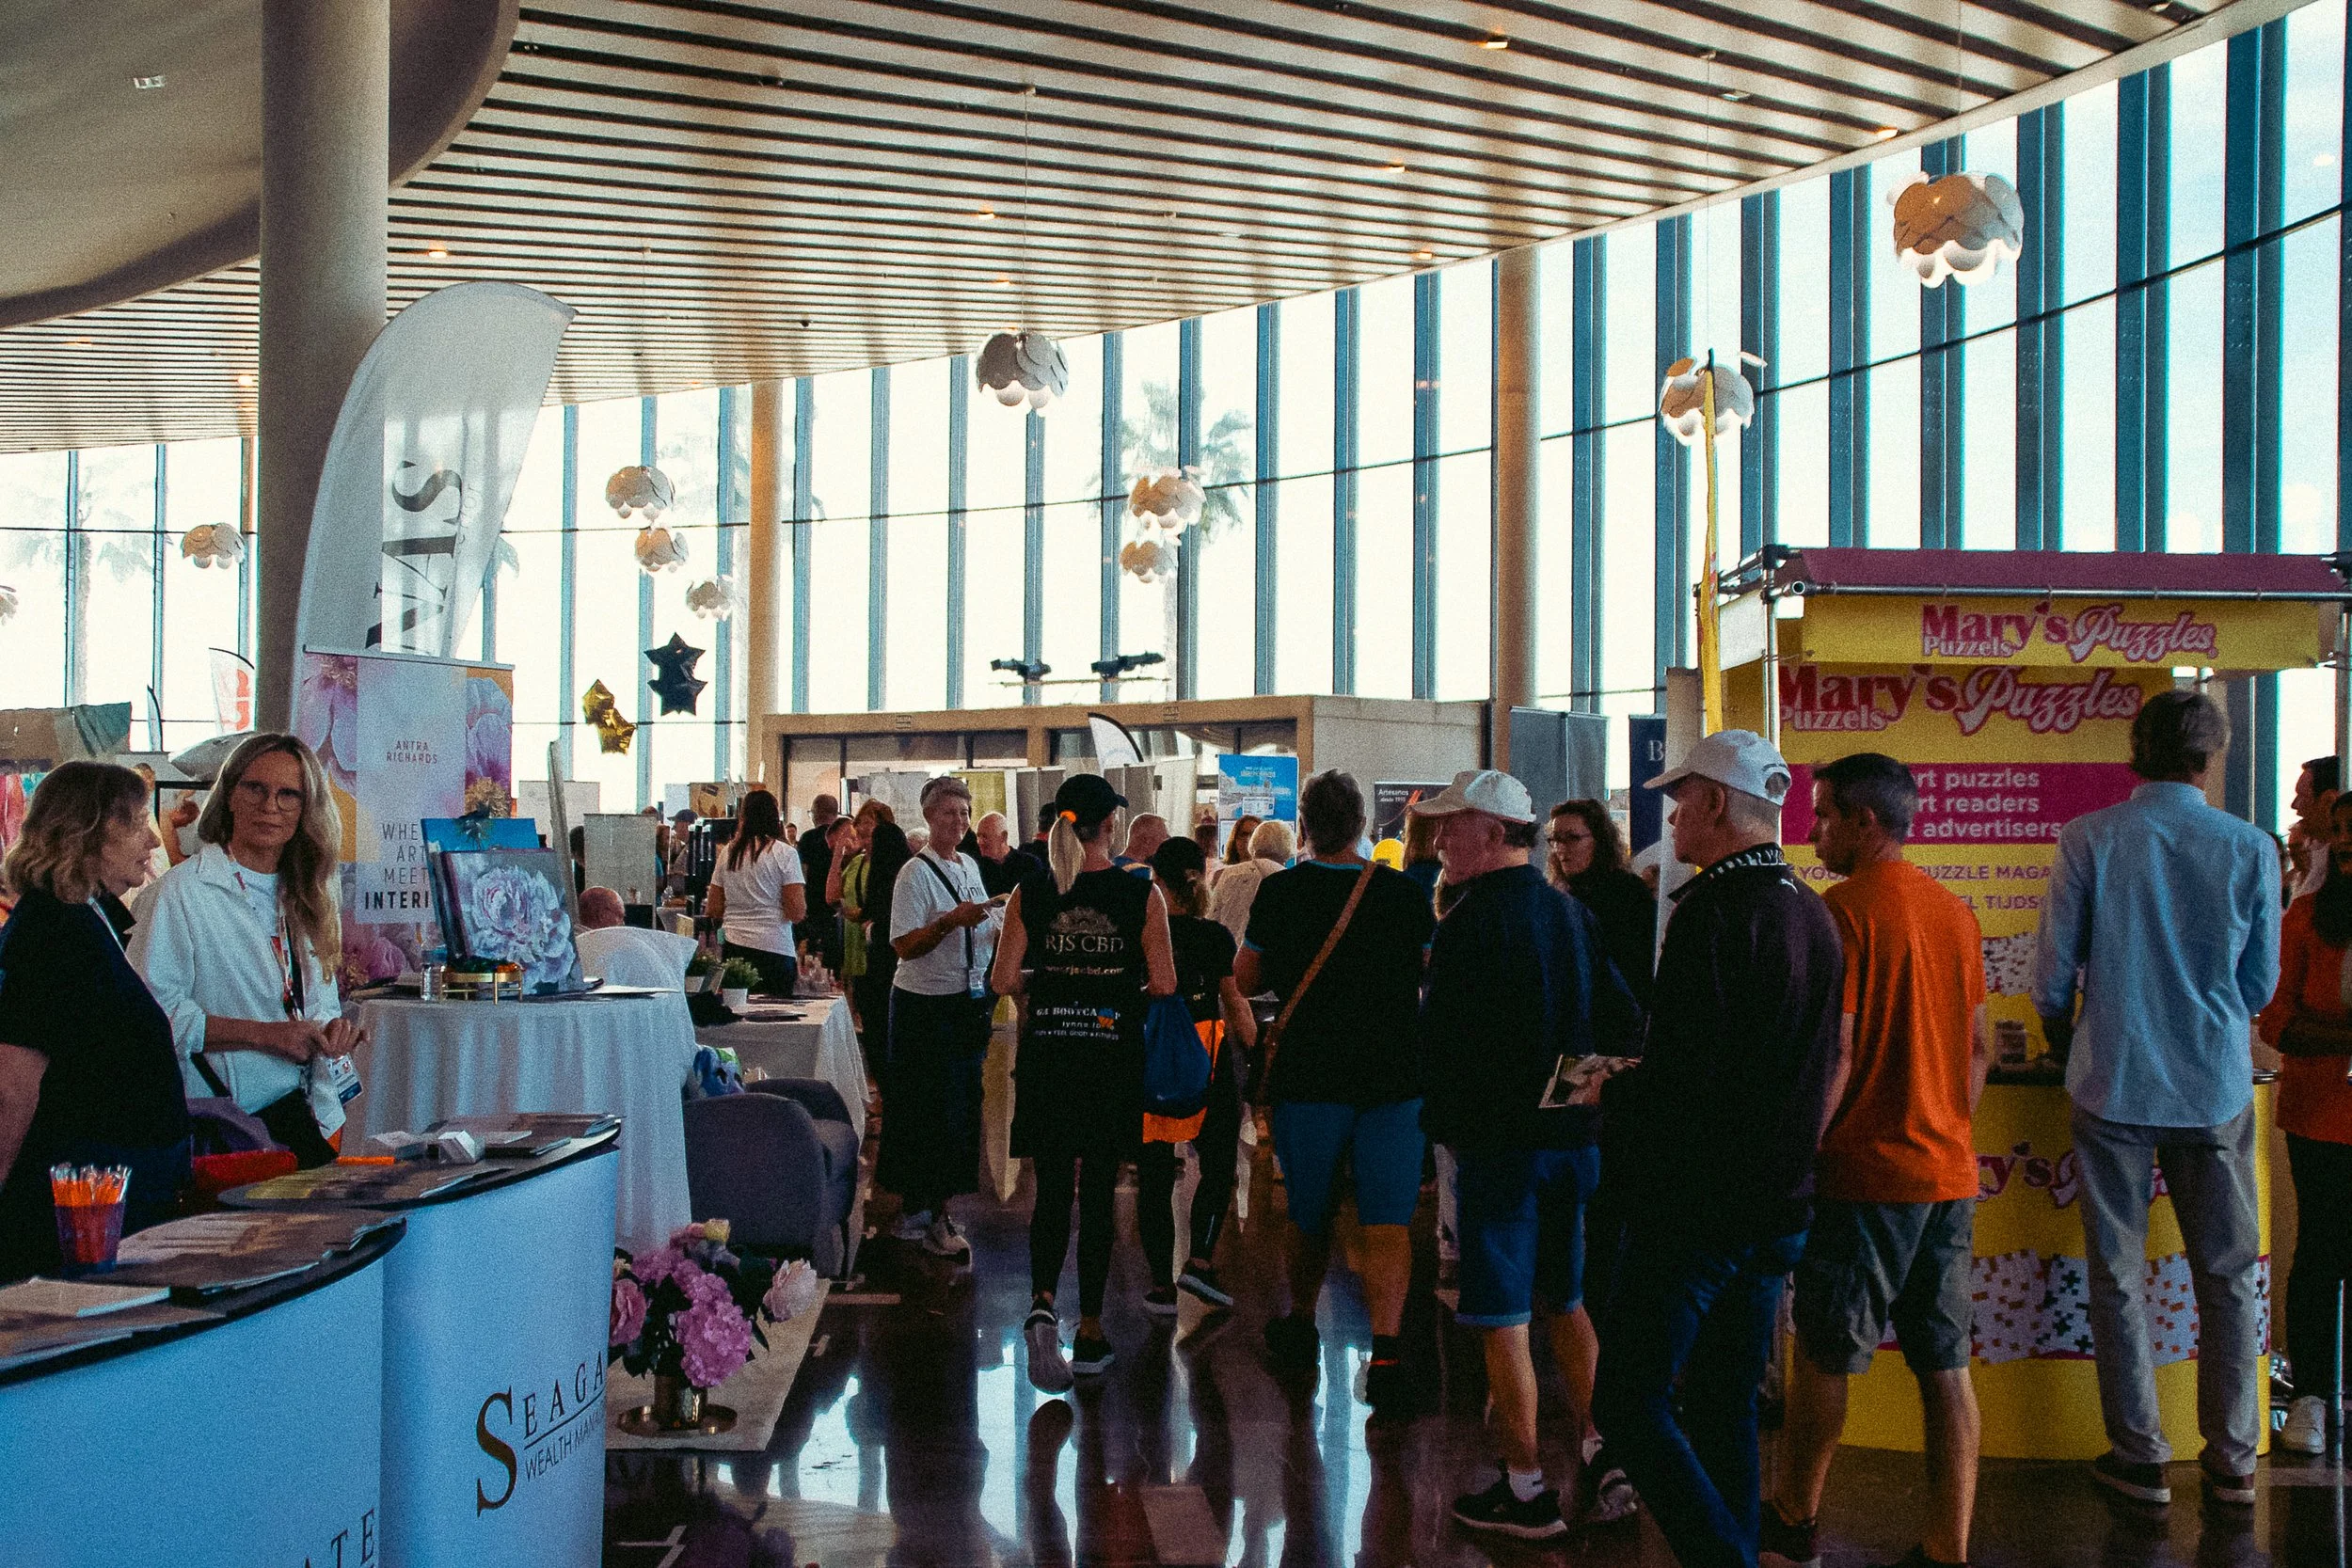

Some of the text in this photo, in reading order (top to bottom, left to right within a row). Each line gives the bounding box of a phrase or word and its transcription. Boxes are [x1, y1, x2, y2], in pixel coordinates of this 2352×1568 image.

[1922, 601, 2215, 660] Mary's Puzzles
[1922, 636, 2013, 657] Puzzels
[1779, 662, 2142, 736] Mary's Puzzles
[395, 740, 429, 752] ANTRA
[386, 752, 437, 764] RICHARDS
[1945, 768, 2040, 791] puzzles
[1946, 794, 2040, 813] readers
[1923, 817, 2062, 838] advertisers
[1046, 934, 1124, 955] RJS CBD
[525, 1431, 573, 1482] WEALTH
